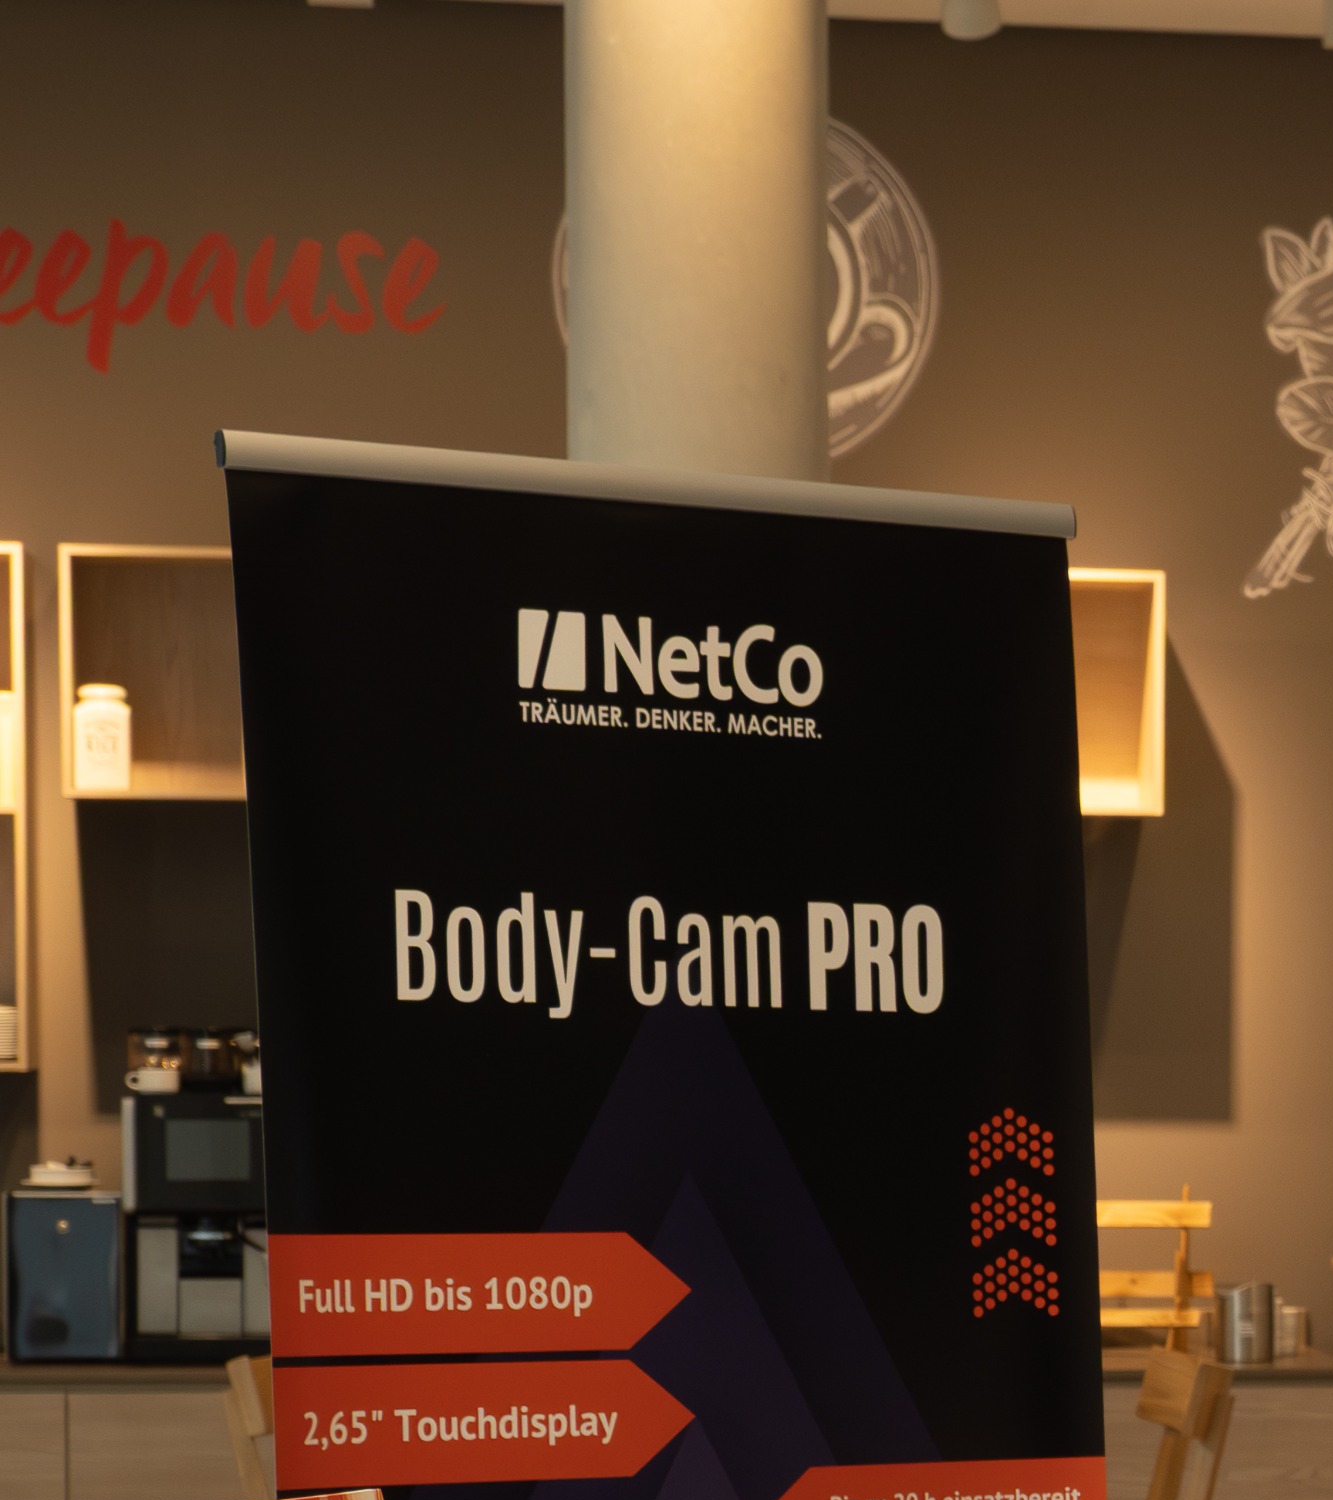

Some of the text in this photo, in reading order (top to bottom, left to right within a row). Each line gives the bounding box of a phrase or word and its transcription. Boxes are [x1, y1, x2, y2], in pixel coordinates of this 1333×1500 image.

[601, 613, 823, 707] NetCo
[519, 698, 822, 739] TRÄUMER. DENKER. MACHER.
[394, 888, 944, 1019] Body-Cam PRO
[298, 1275, 594, 1317] Full HD bis 1080p
[303, 1404, 618, 1451] 2,65" Touchdisplay
